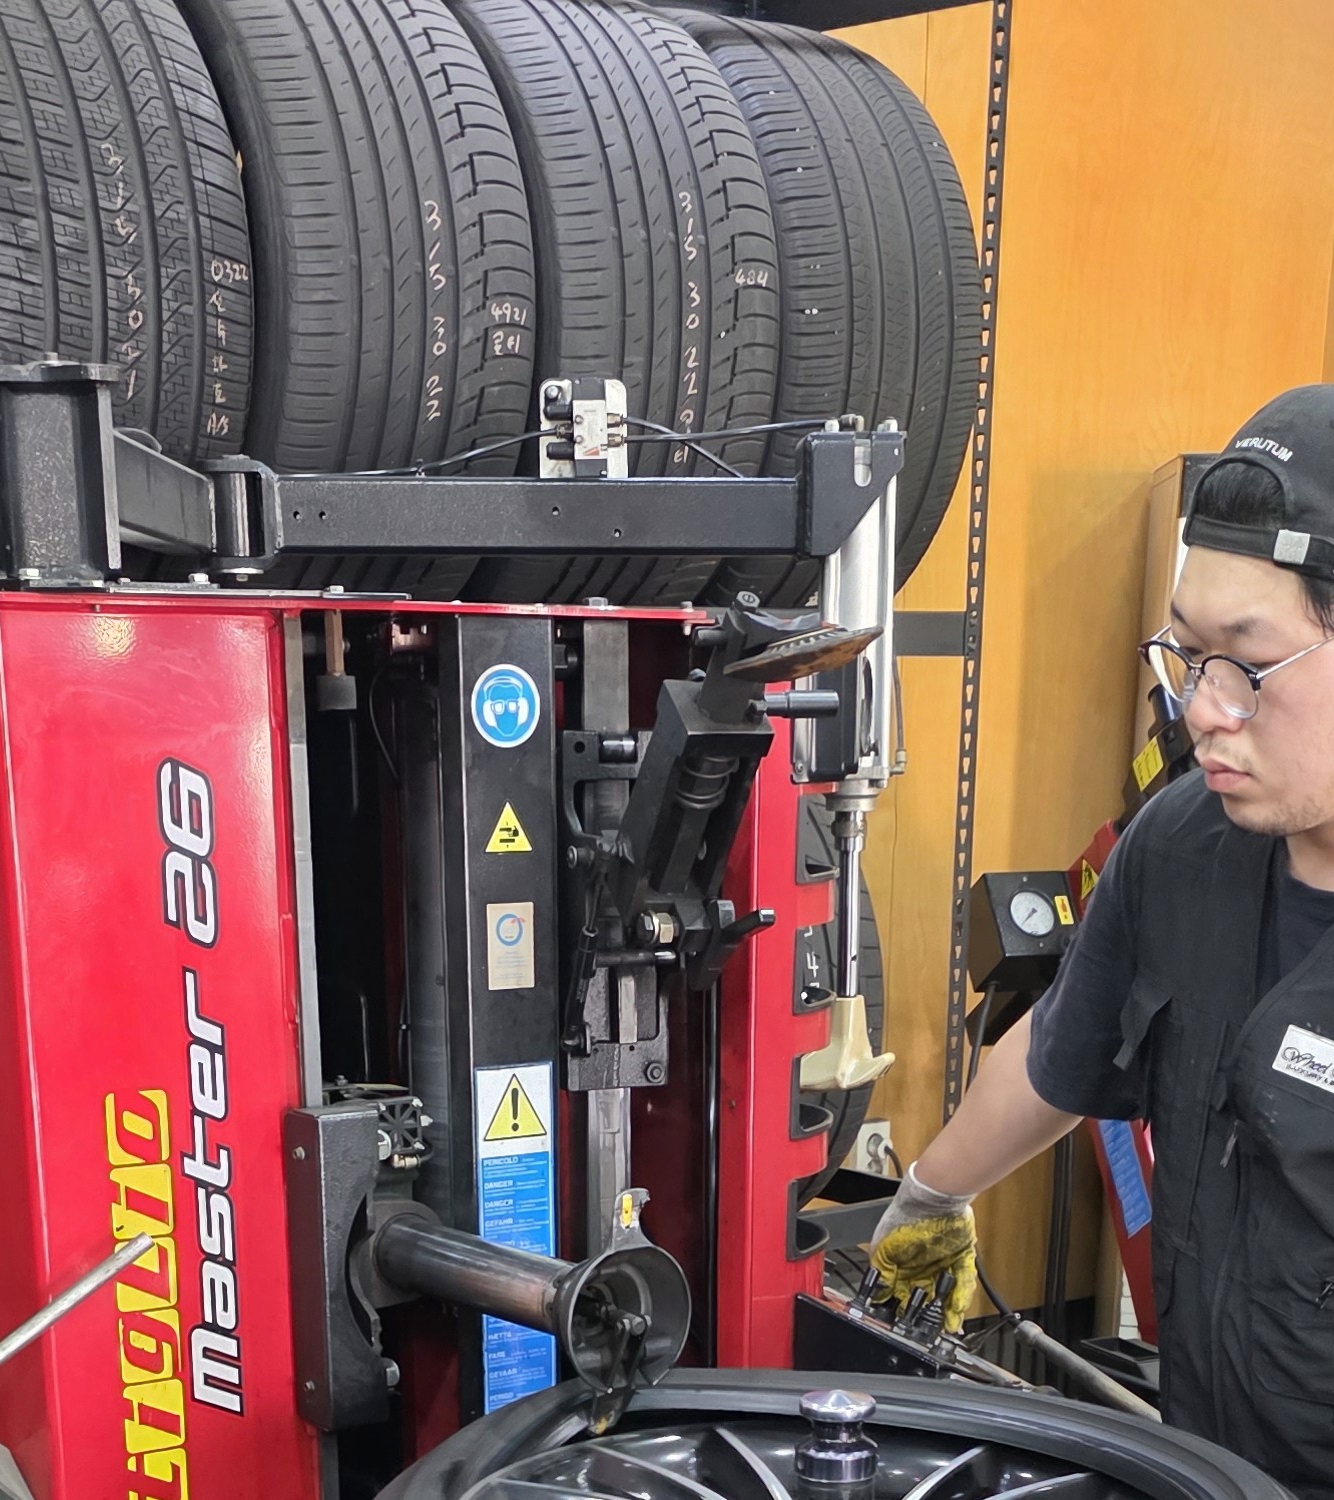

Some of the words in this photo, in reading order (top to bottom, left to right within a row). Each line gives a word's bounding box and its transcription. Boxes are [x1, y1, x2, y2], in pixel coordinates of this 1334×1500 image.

[210, 259, 250, 283] 0322
[490, 302, 528, 326] 4921
[1235, 437, 1294, 462] VERUTUM
[154, 756, 219, 949] 26
[1280, 1046, 1333, 1075] Wheel
